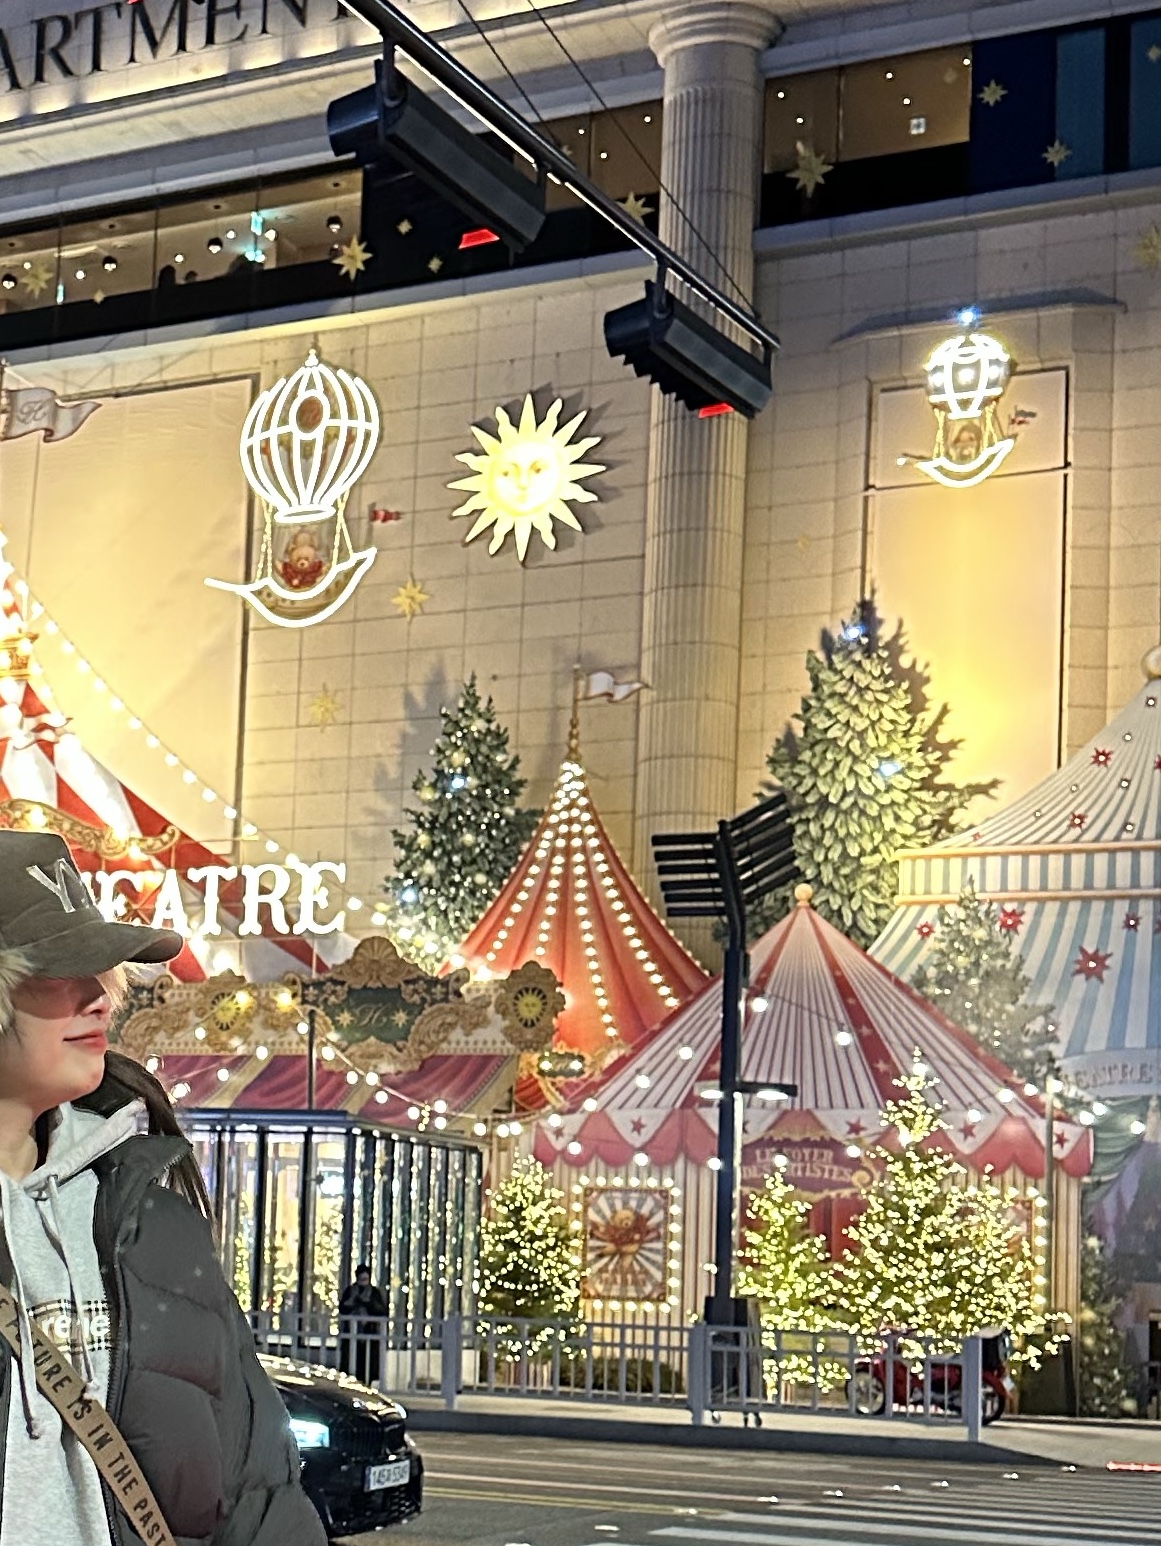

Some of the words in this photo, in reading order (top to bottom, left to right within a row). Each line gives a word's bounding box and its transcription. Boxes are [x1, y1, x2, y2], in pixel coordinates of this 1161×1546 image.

[80, 861, 347, 938] EATRE
[66, 1393, 93, 1422] IS
[87, 1423, 114, 1453] IN
[108, 1446, 139, 1498] THE
